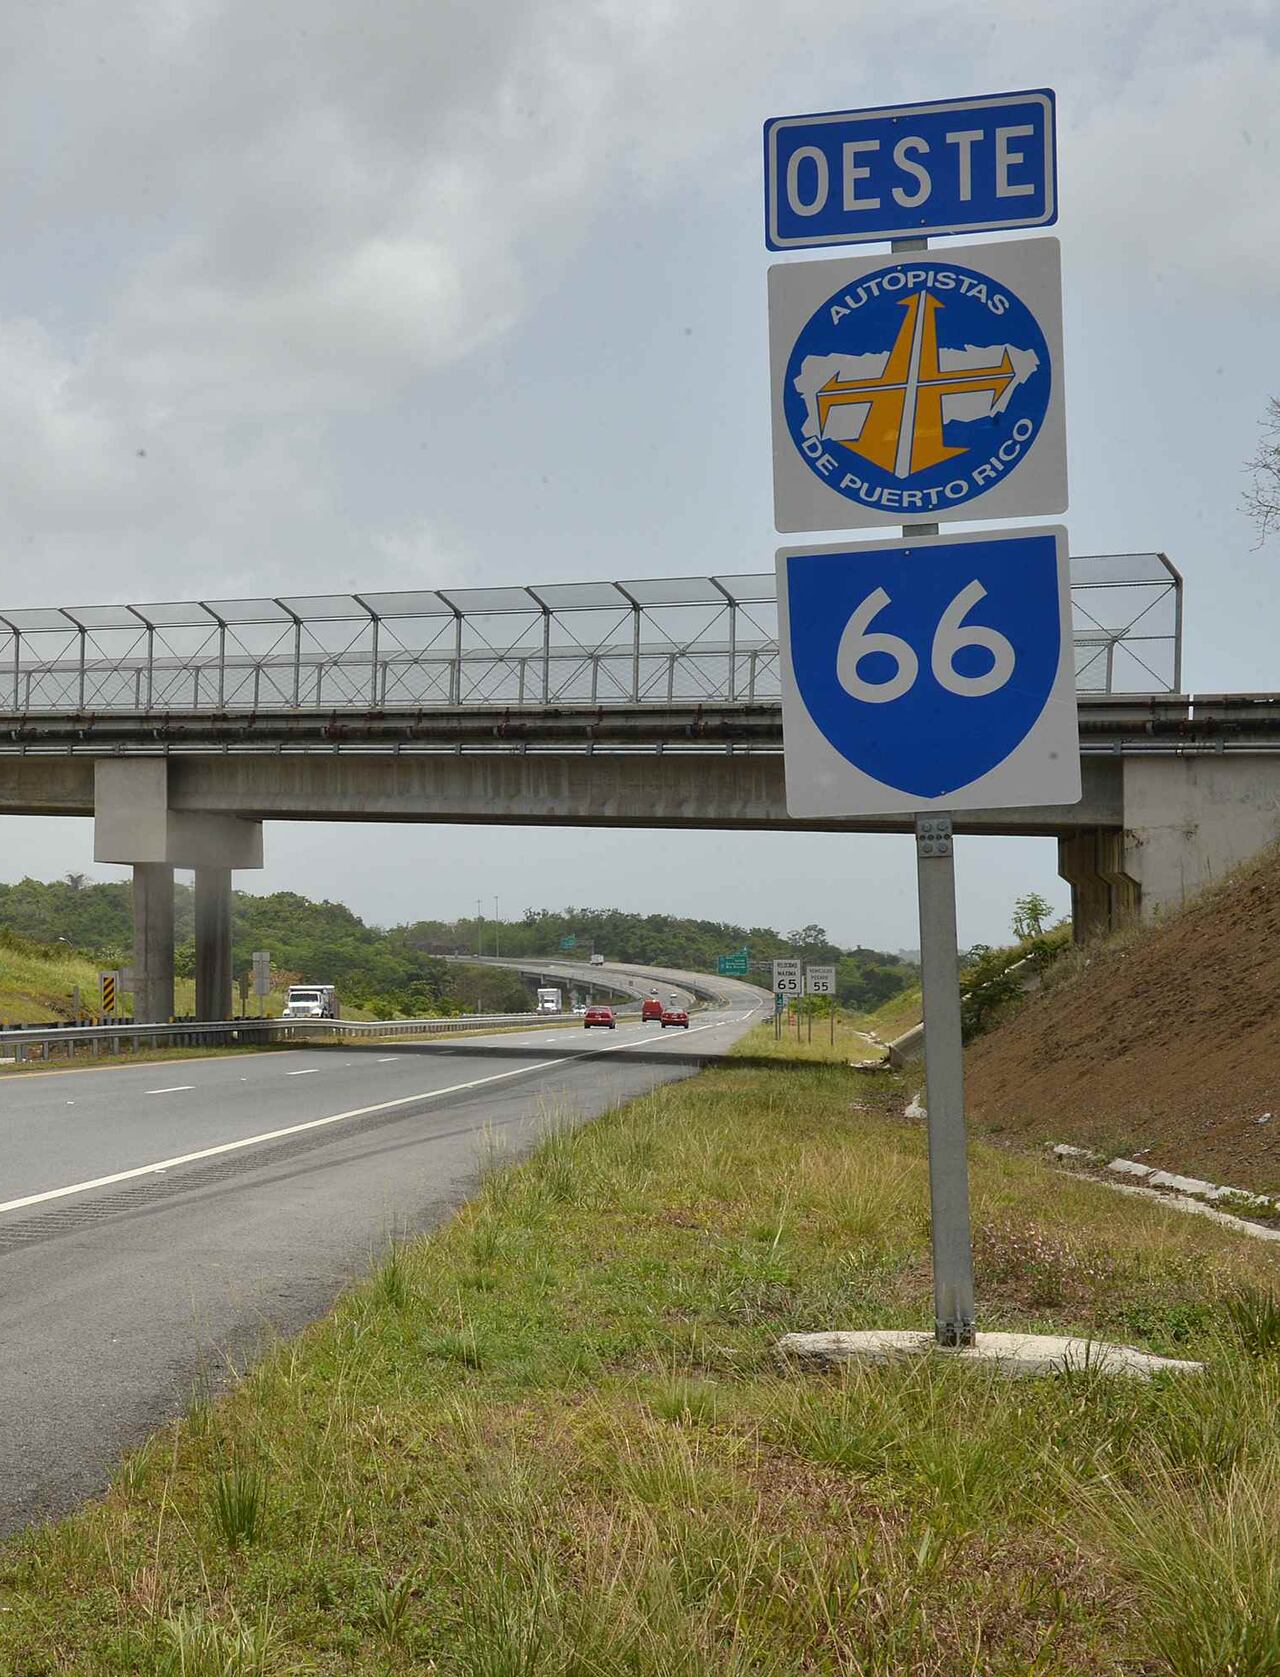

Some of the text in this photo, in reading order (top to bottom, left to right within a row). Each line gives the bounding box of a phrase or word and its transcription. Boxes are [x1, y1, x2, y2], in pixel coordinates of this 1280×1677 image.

[786, 123, 1035, 218] OESTE
[829, 270, 1010, 326] AUTOPISTAS
[800, 417, 1034, 508] DE PUERTO RICO
[836, 578, 1016, 704] 66
[777, 979, 797, 990] 65
[813, 981, 829, 992] 55
